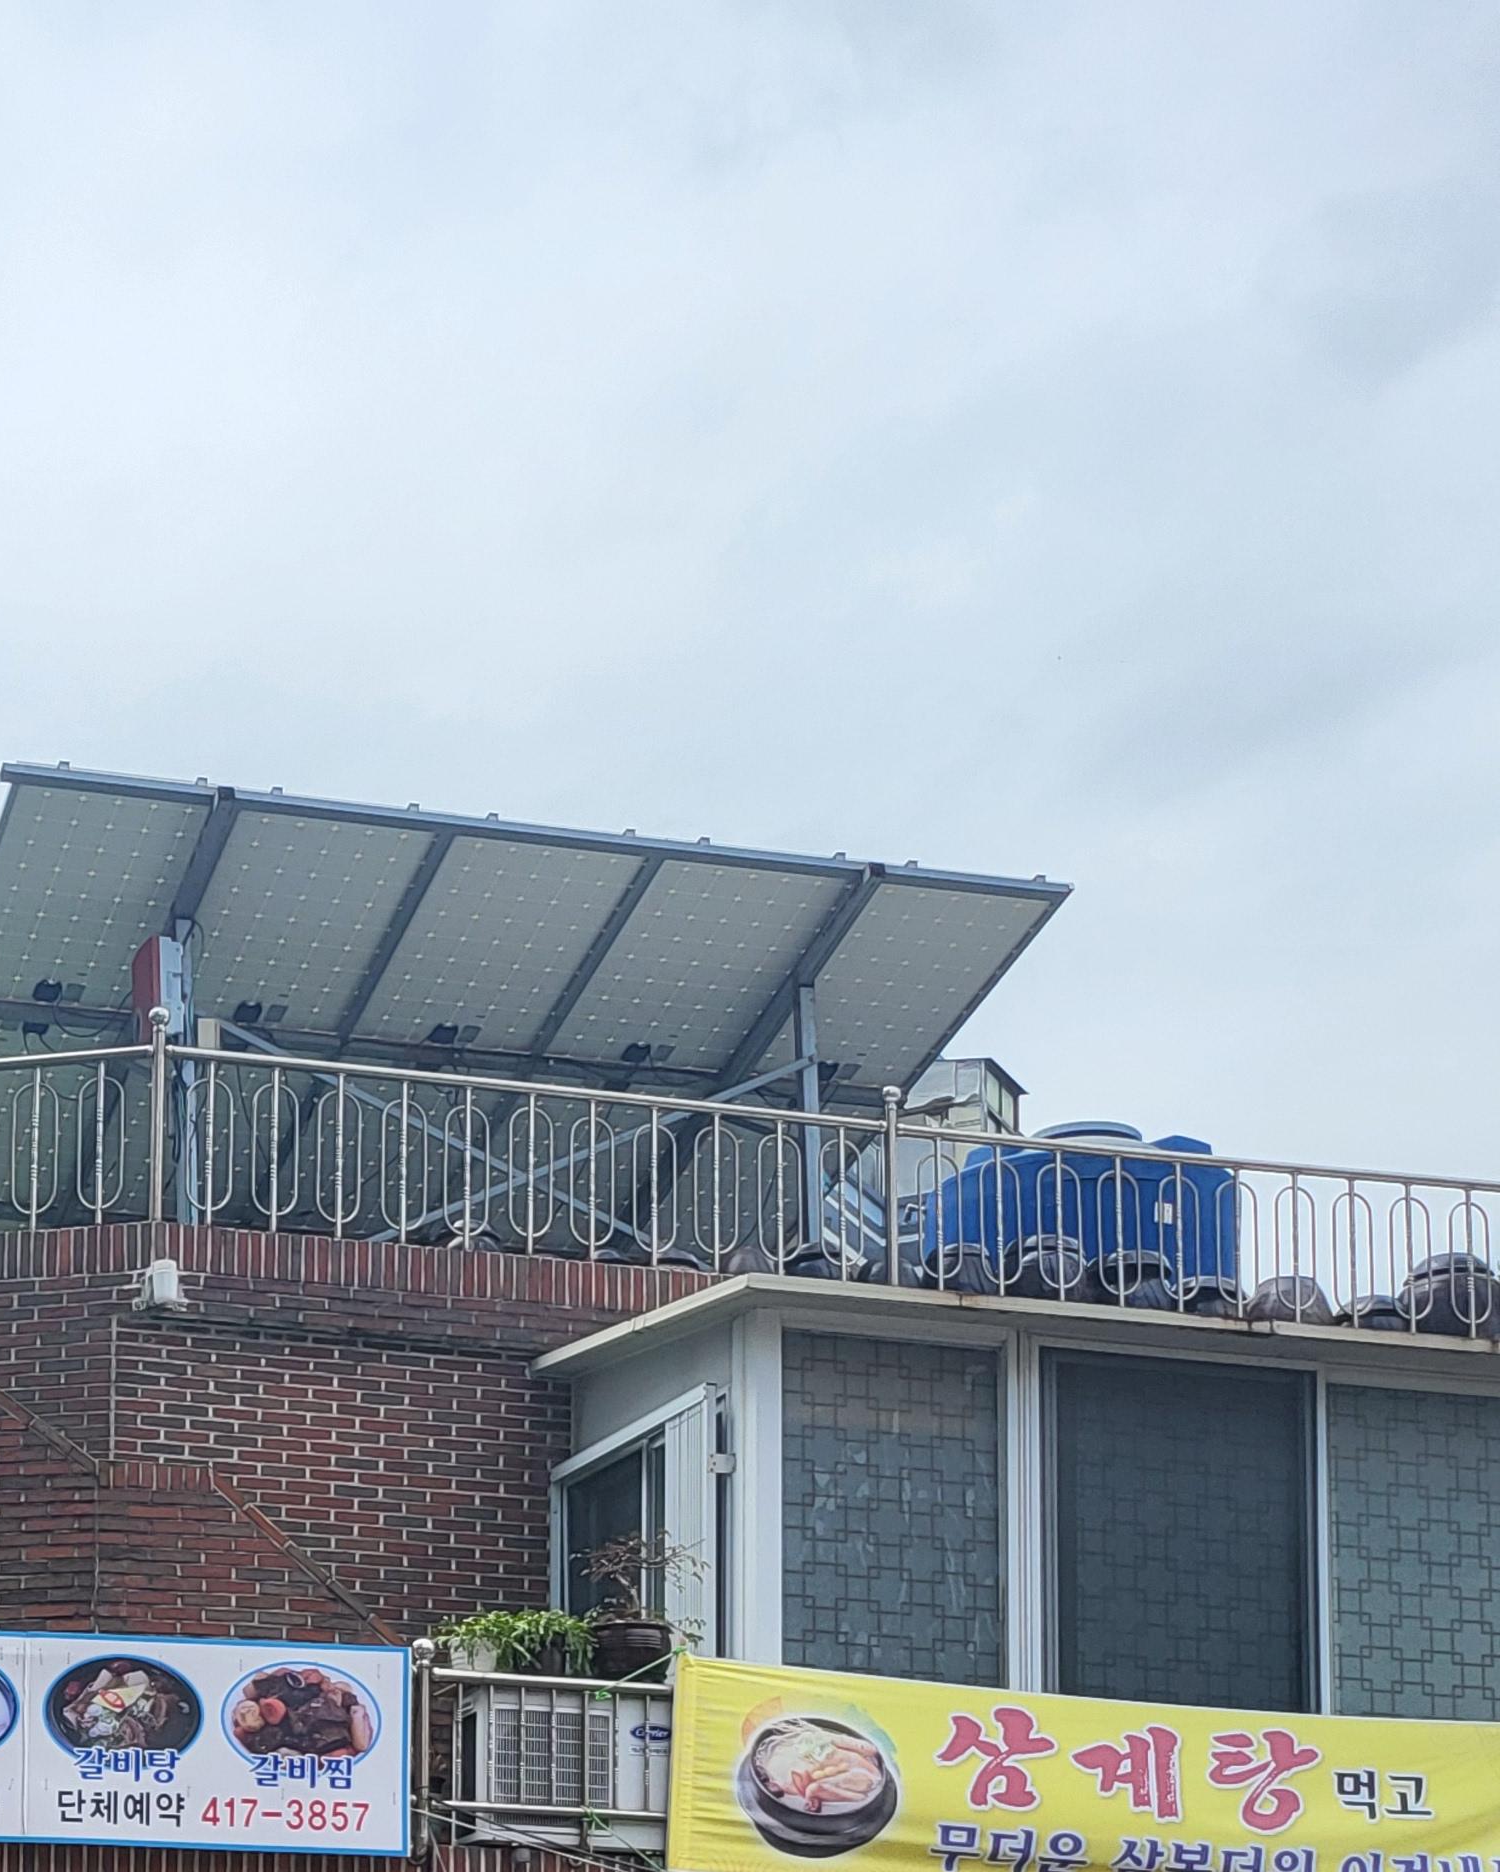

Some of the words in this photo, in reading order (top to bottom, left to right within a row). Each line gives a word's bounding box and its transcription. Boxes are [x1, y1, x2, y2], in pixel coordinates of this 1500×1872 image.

[74, 1746, 181, 1784] 갈비탕
[249, 1753, 354, 1791] 갈비찜
[936, 1706, 1320, 1834] 삼계탕
[56, 1788, 186, 1828] 단체예약
[200, 1797, 371, 1832] 417-3857
[1334, 1769, 1435, 1821] 먹고
